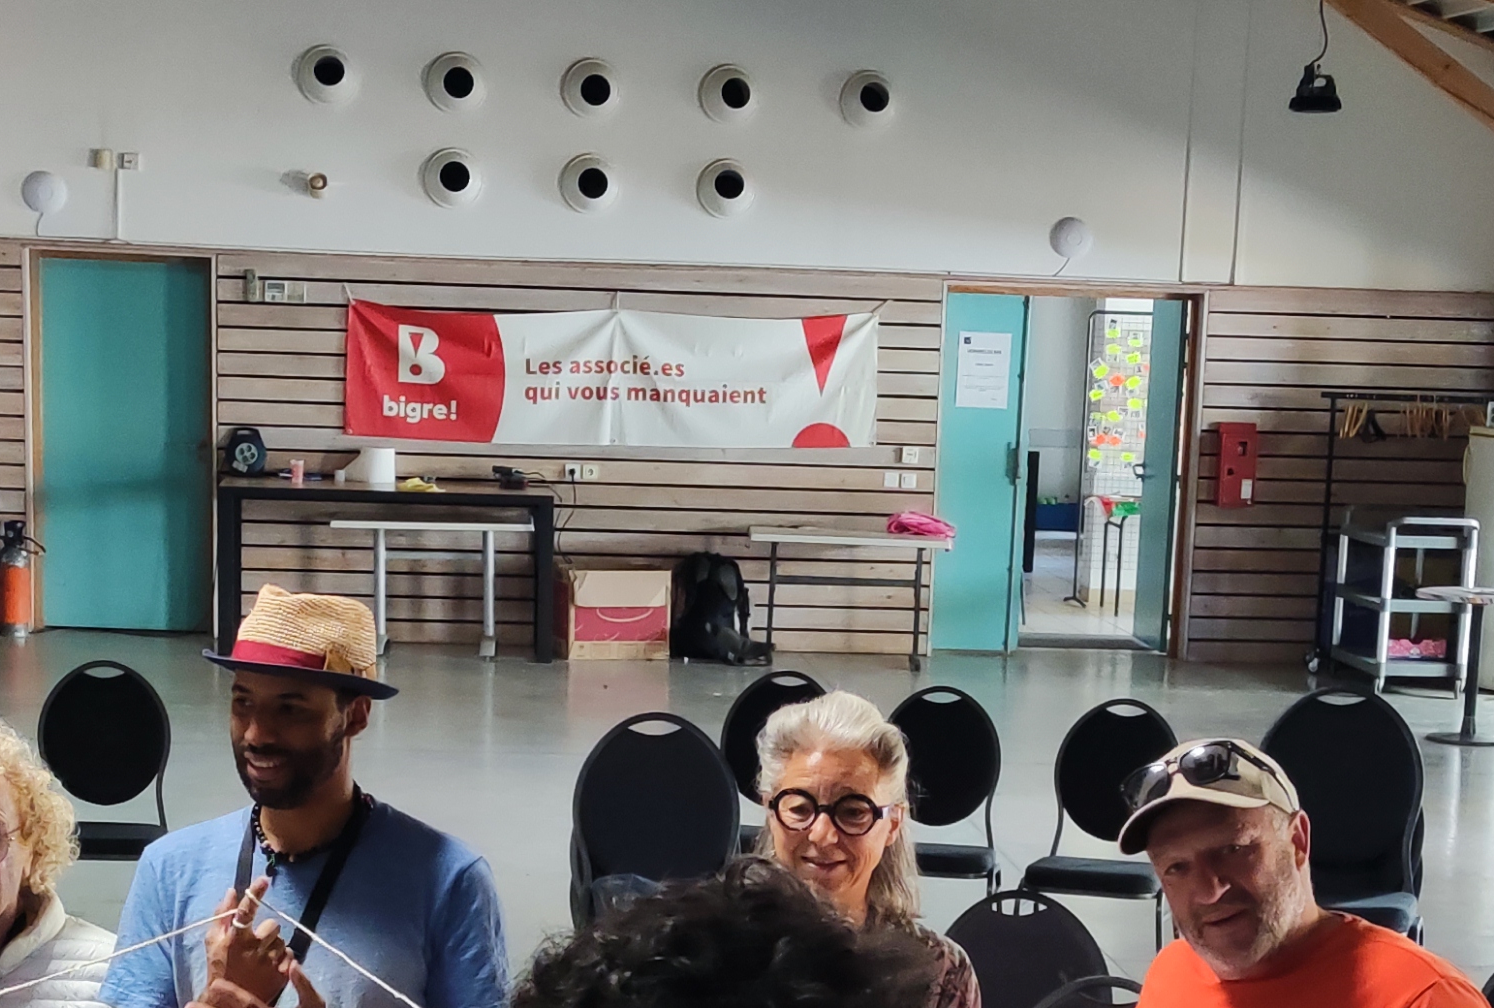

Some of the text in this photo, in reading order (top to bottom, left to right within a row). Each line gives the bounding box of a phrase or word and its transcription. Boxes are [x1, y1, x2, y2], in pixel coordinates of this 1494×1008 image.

[525, 354, 685, 378] Les associé.es
[524, 381, 767, 407] qui vous manquaient
[382, 394, 458, 424] bigre!
